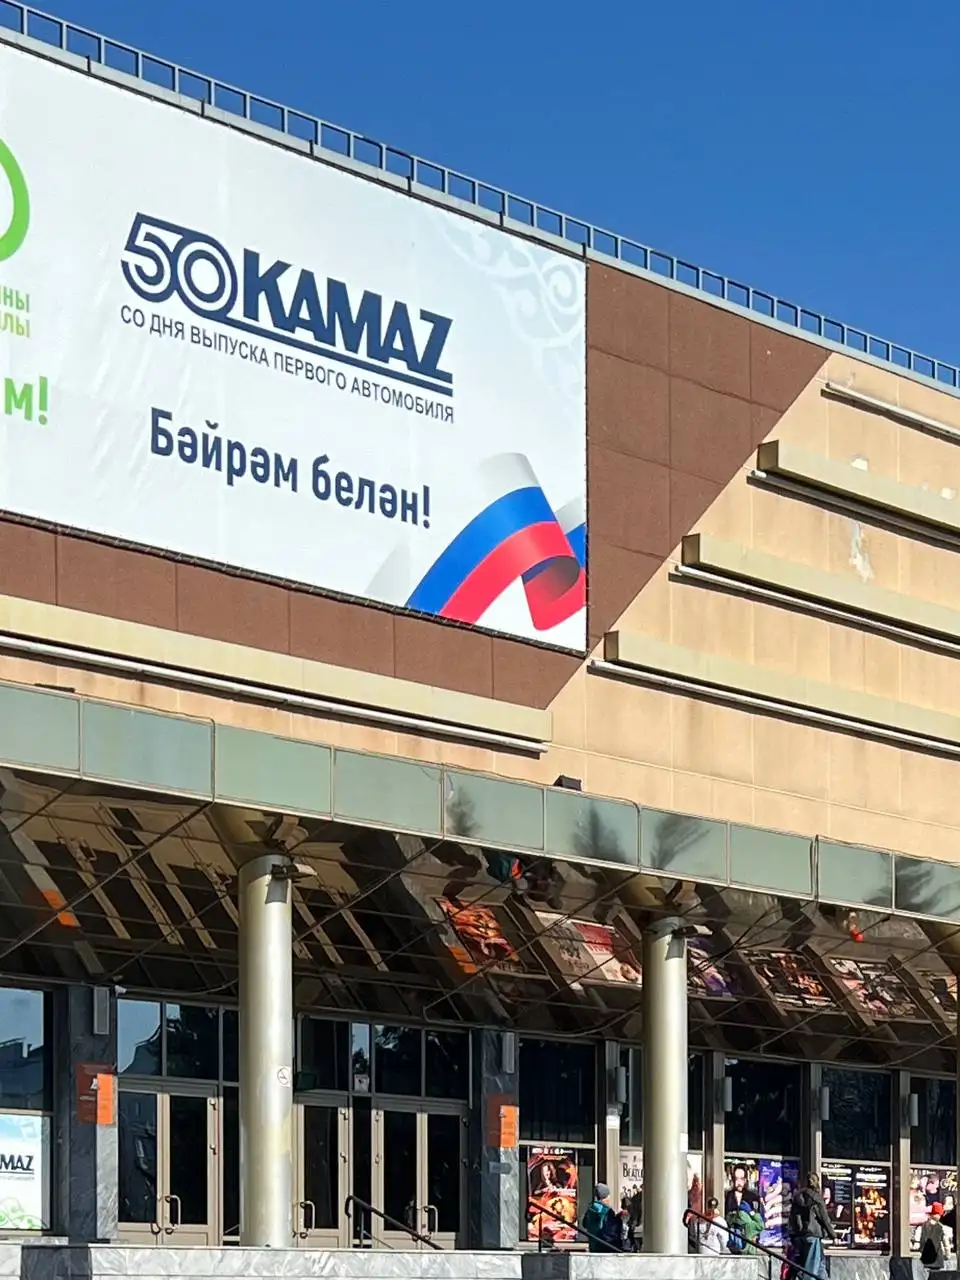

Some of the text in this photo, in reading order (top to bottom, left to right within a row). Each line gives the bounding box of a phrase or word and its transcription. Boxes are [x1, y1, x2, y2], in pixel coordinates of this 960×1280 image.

[120, 211, 454, 385] 50 KAMAZ
[120, 305, 455, 424] СО ДНЯ ВЫПУСКА ПЕРВОГО АВТОМОБИЛЯ
[150, 406, 430, 529] Бәйрәм белән!
